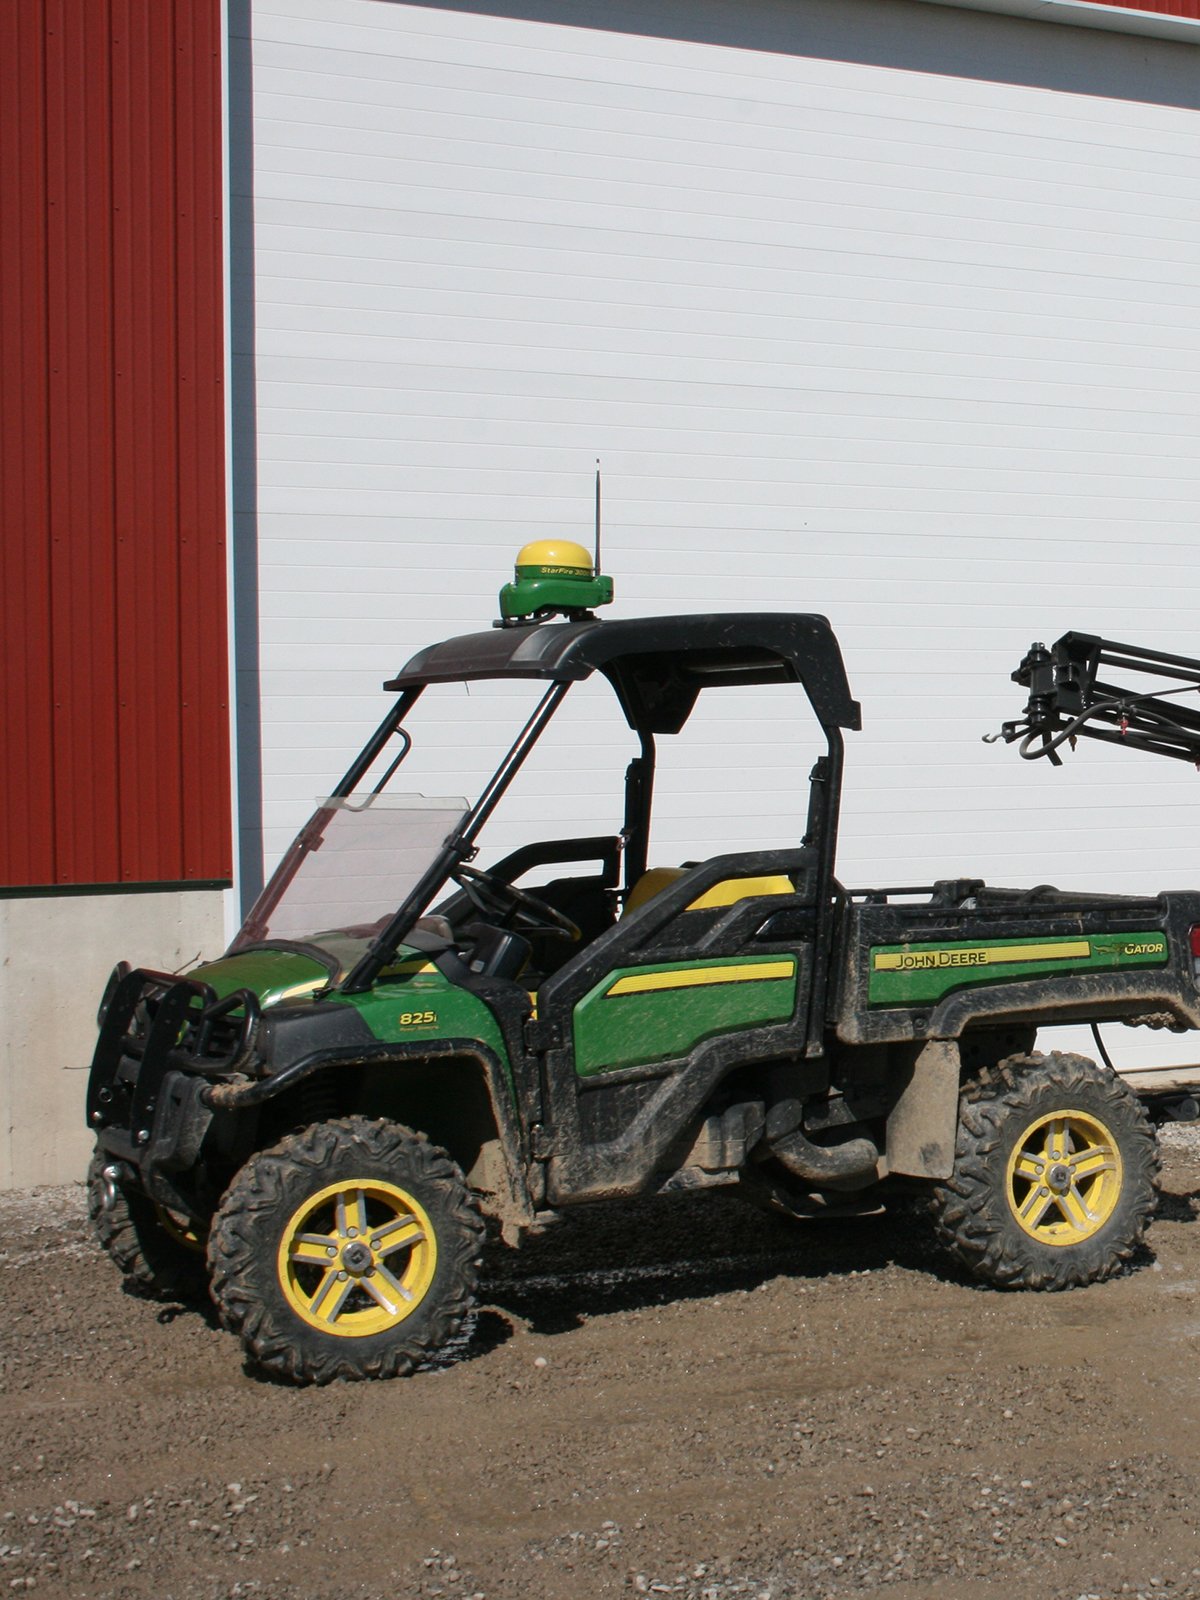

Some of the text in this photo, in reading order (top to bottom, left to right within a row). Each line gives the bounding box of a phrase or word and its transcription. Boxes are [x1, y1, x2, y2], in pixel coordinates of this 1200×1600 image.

[541, 567, 573, 575] StarFire
[1125, 943, 1164, 955] GATOR
[896, 952, 986, 969] JOHN DEERE
